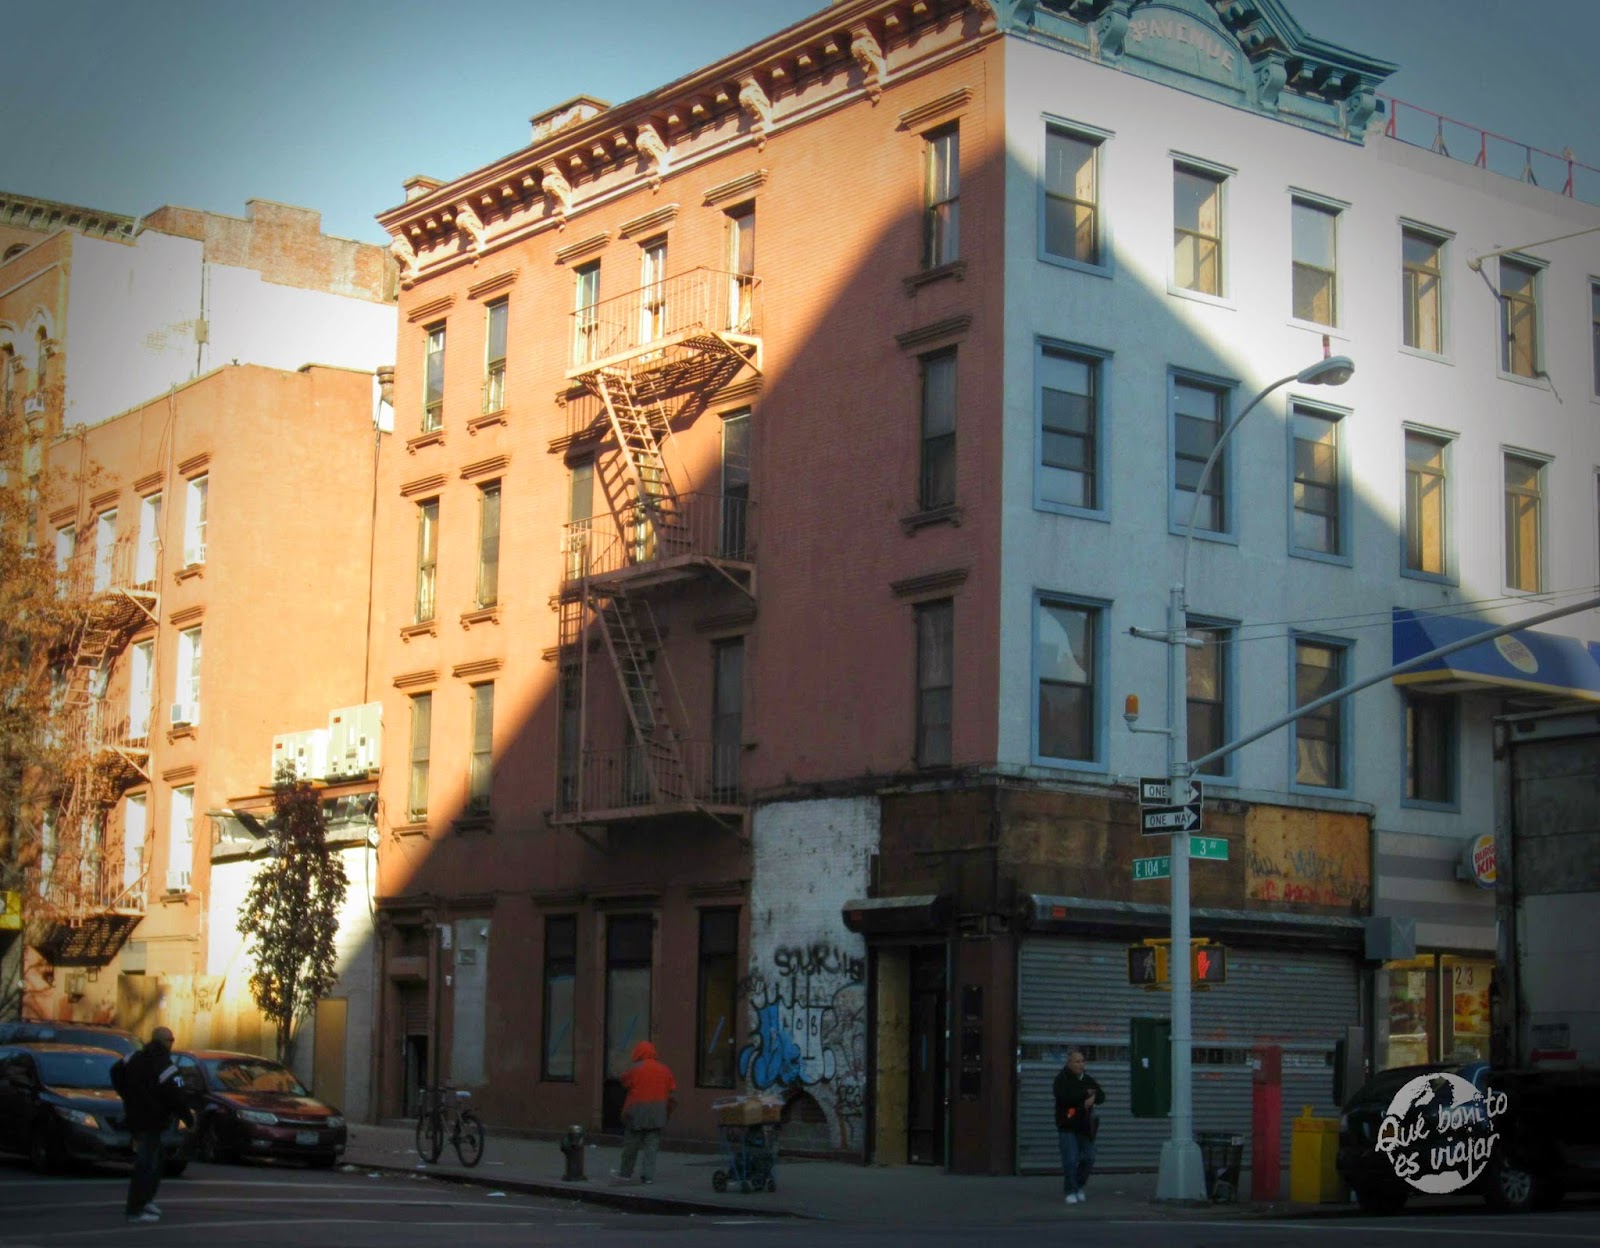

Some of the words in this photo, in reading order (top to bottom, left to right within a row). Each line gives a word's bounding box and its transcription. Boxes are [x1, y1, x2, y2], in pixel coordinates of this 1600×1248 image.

[1149, 20, 1235, 72] AVENUE
[1149, 786, 1167, 797] ONE
[1149, 815, 1167, 826] ONE
[1174, 813, 1192, 825] WAY
[1200, 840, 1207, 856] 3
[1135, 862, 1141, 878] E
[1145, 861, 1159, 876] 104
[1477, 856, 1497, 877] KIN
